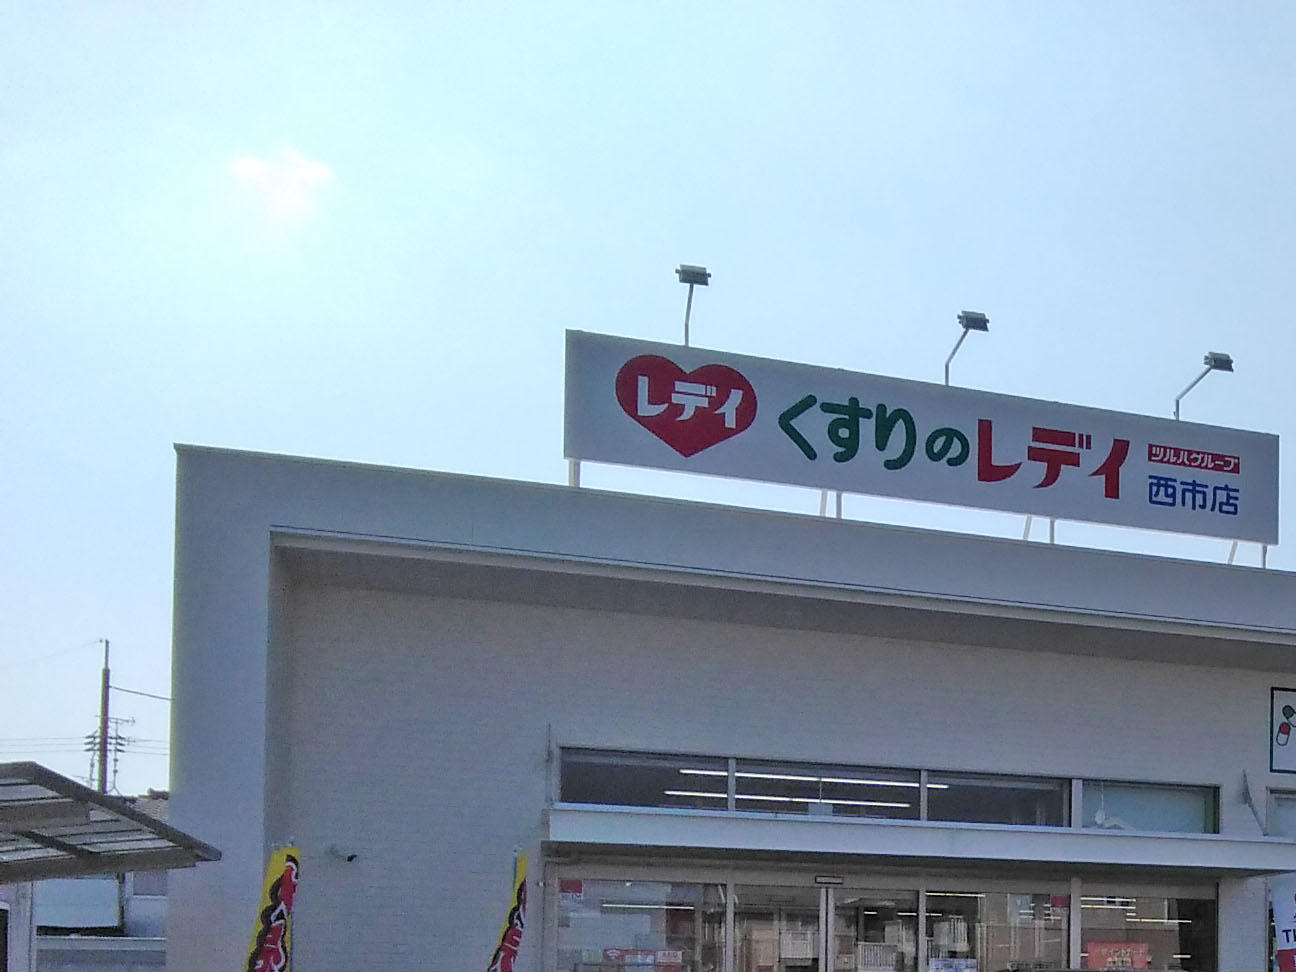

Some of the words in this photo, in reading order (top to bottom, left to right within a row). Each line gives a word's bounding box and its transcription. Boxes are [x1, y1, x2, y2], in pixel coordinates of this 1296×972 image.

[1151, 446, 1239, 471] ツルハグループ
[1148, 475, 1240, 515] 西市店
